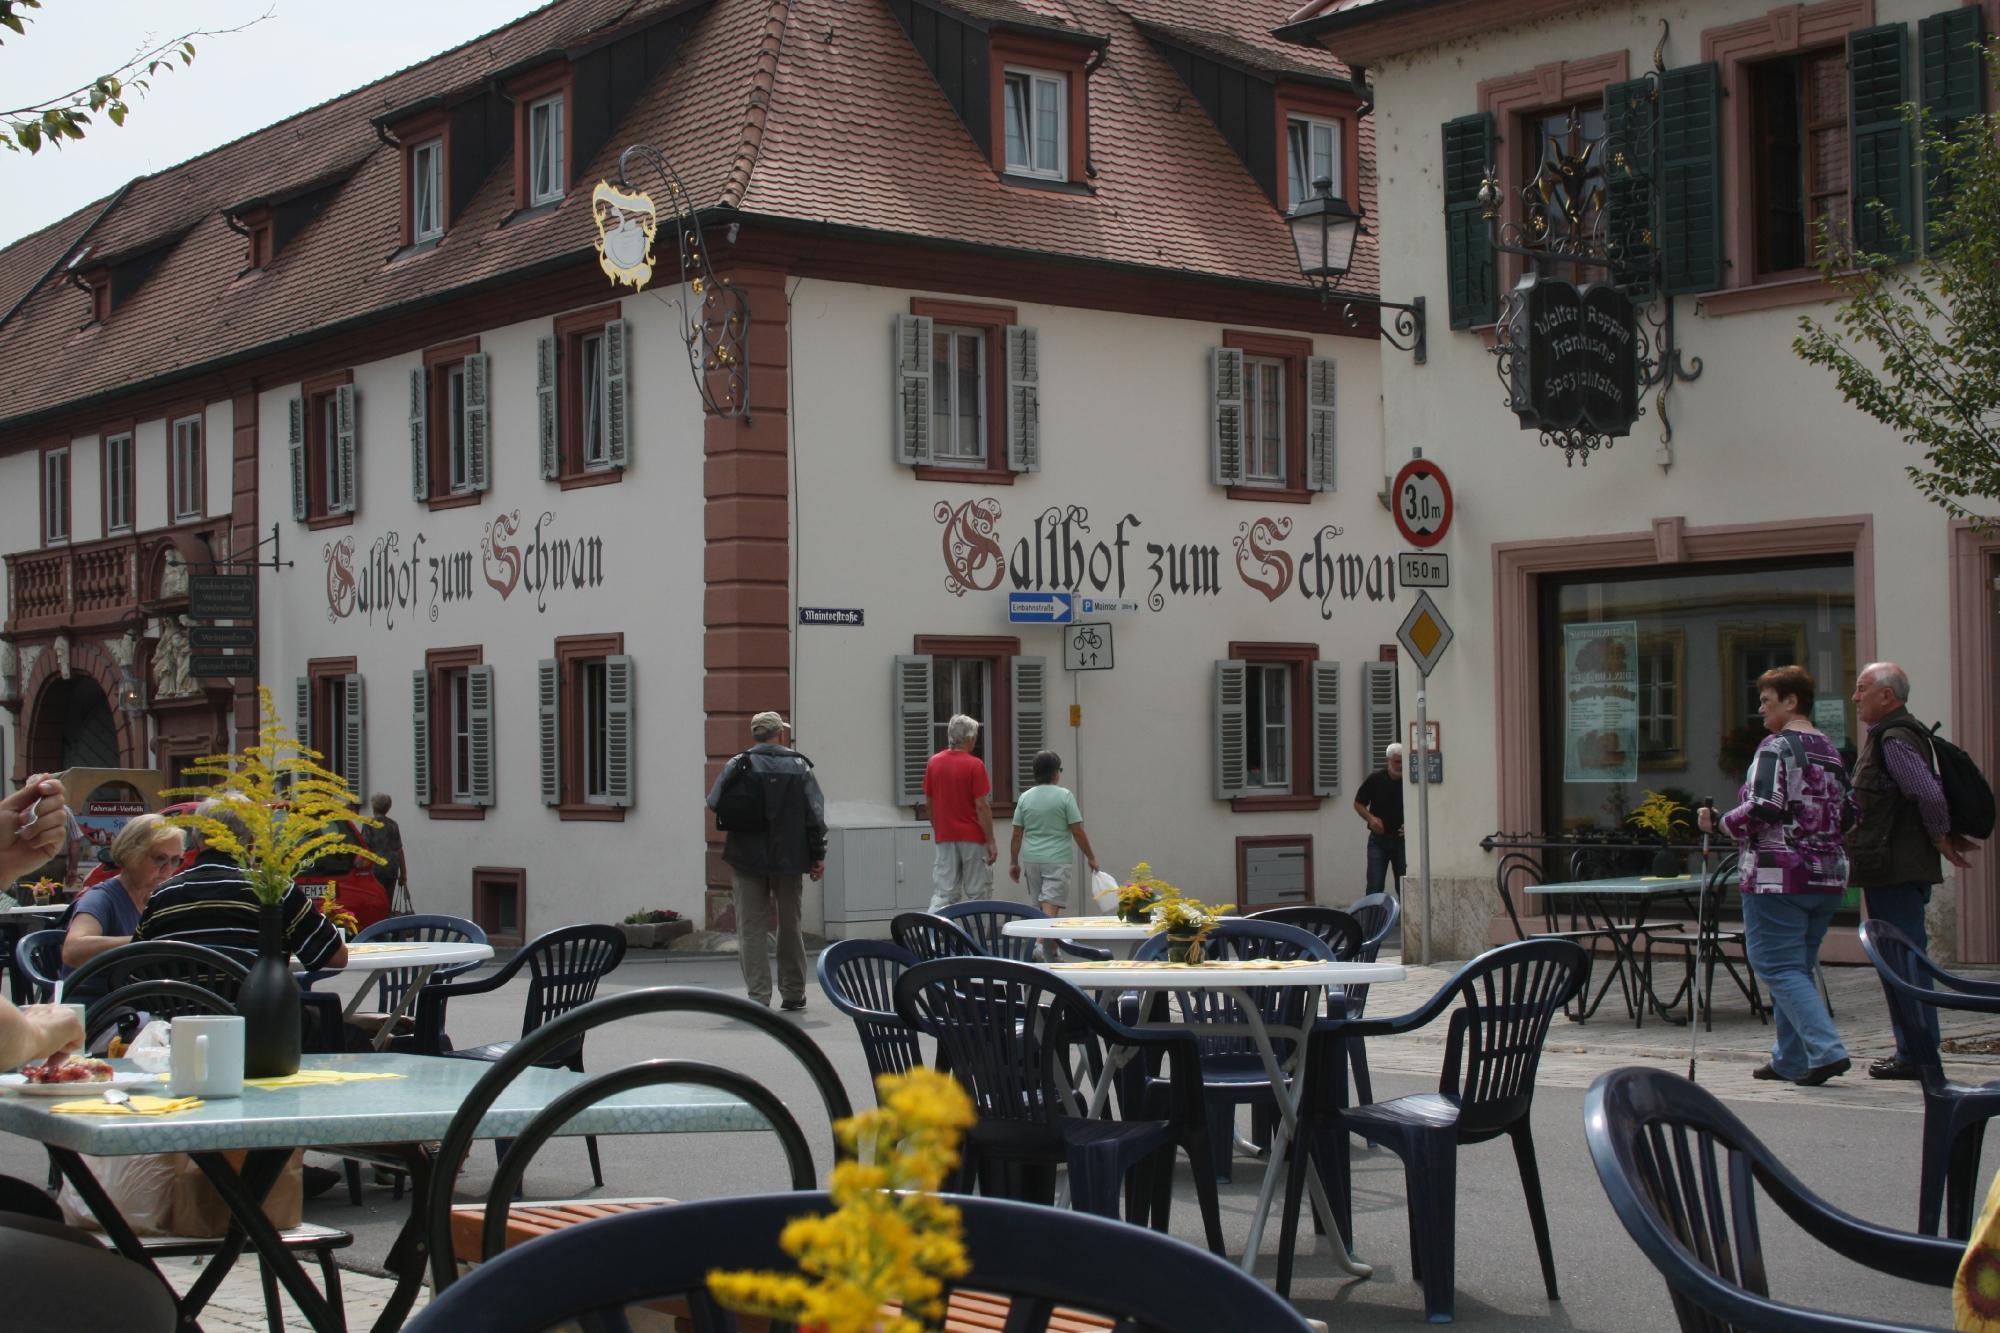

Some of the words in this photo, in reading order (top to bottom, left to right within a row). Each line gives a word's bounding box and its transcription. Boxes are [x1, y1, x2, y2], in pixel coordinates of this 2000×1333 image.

[1534, 304, 1579, 335] Walter
[429, 550, 473, 623] zum
[481, 508, 605, 614] Schwan
[1146, 540, 1222, 612] zum
[1406, 561, 1429, 578] 150
[1012, 603, 1054, 612] Einbahnstraße
